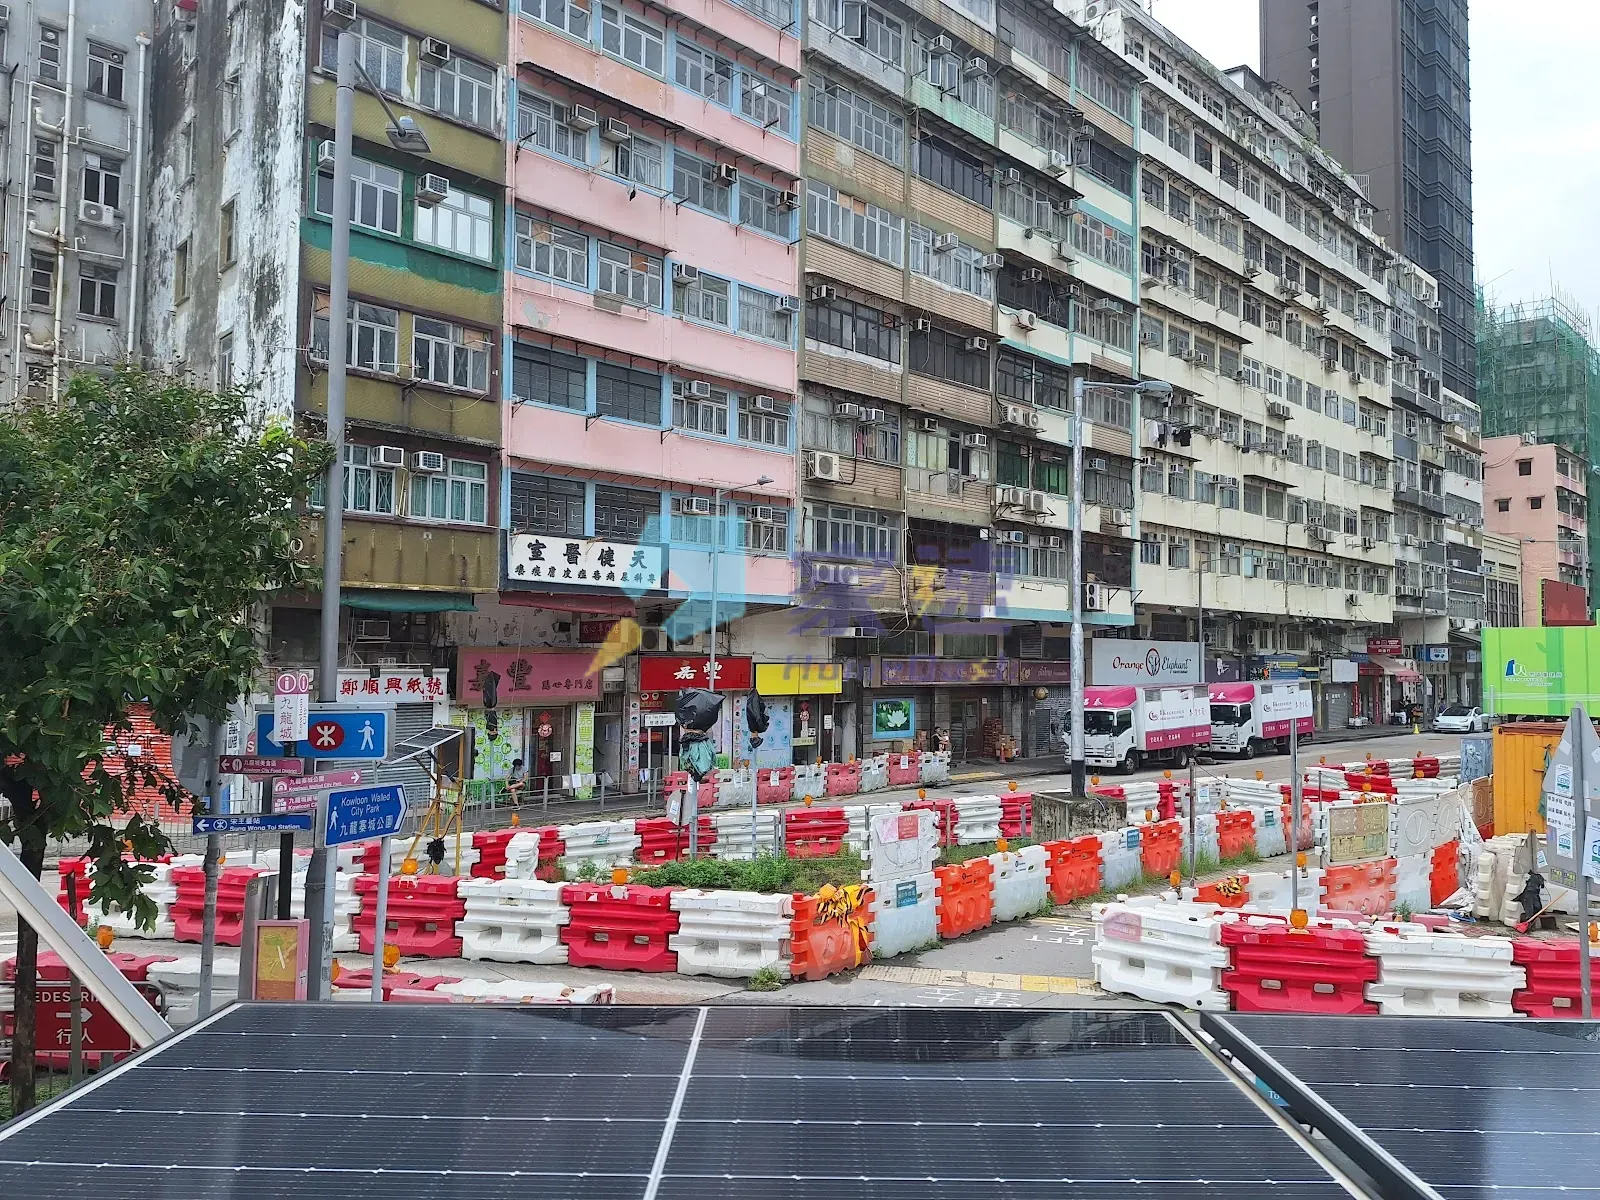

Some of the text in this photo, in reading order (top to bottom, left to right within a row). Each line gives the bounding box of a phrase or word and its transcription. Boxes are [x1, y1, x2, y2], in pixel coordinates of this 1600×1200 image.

[527, 539, 648, 569] 天健醫室
[1112, 656, 1191, 676] Orange Elephant
[340, 677, 444, 696] 鄭順興紙號
[541, 679, 594, 690] 點心專門店
[279, 696, 293, 740] 九龍城
[341, 792, 391, 807] Kowloon Walled
[350, 805, 380, 816] City Park
[340, 814, 394, 837] 九龍寨城公園
[56, 1028, 94, 1044] 行人
